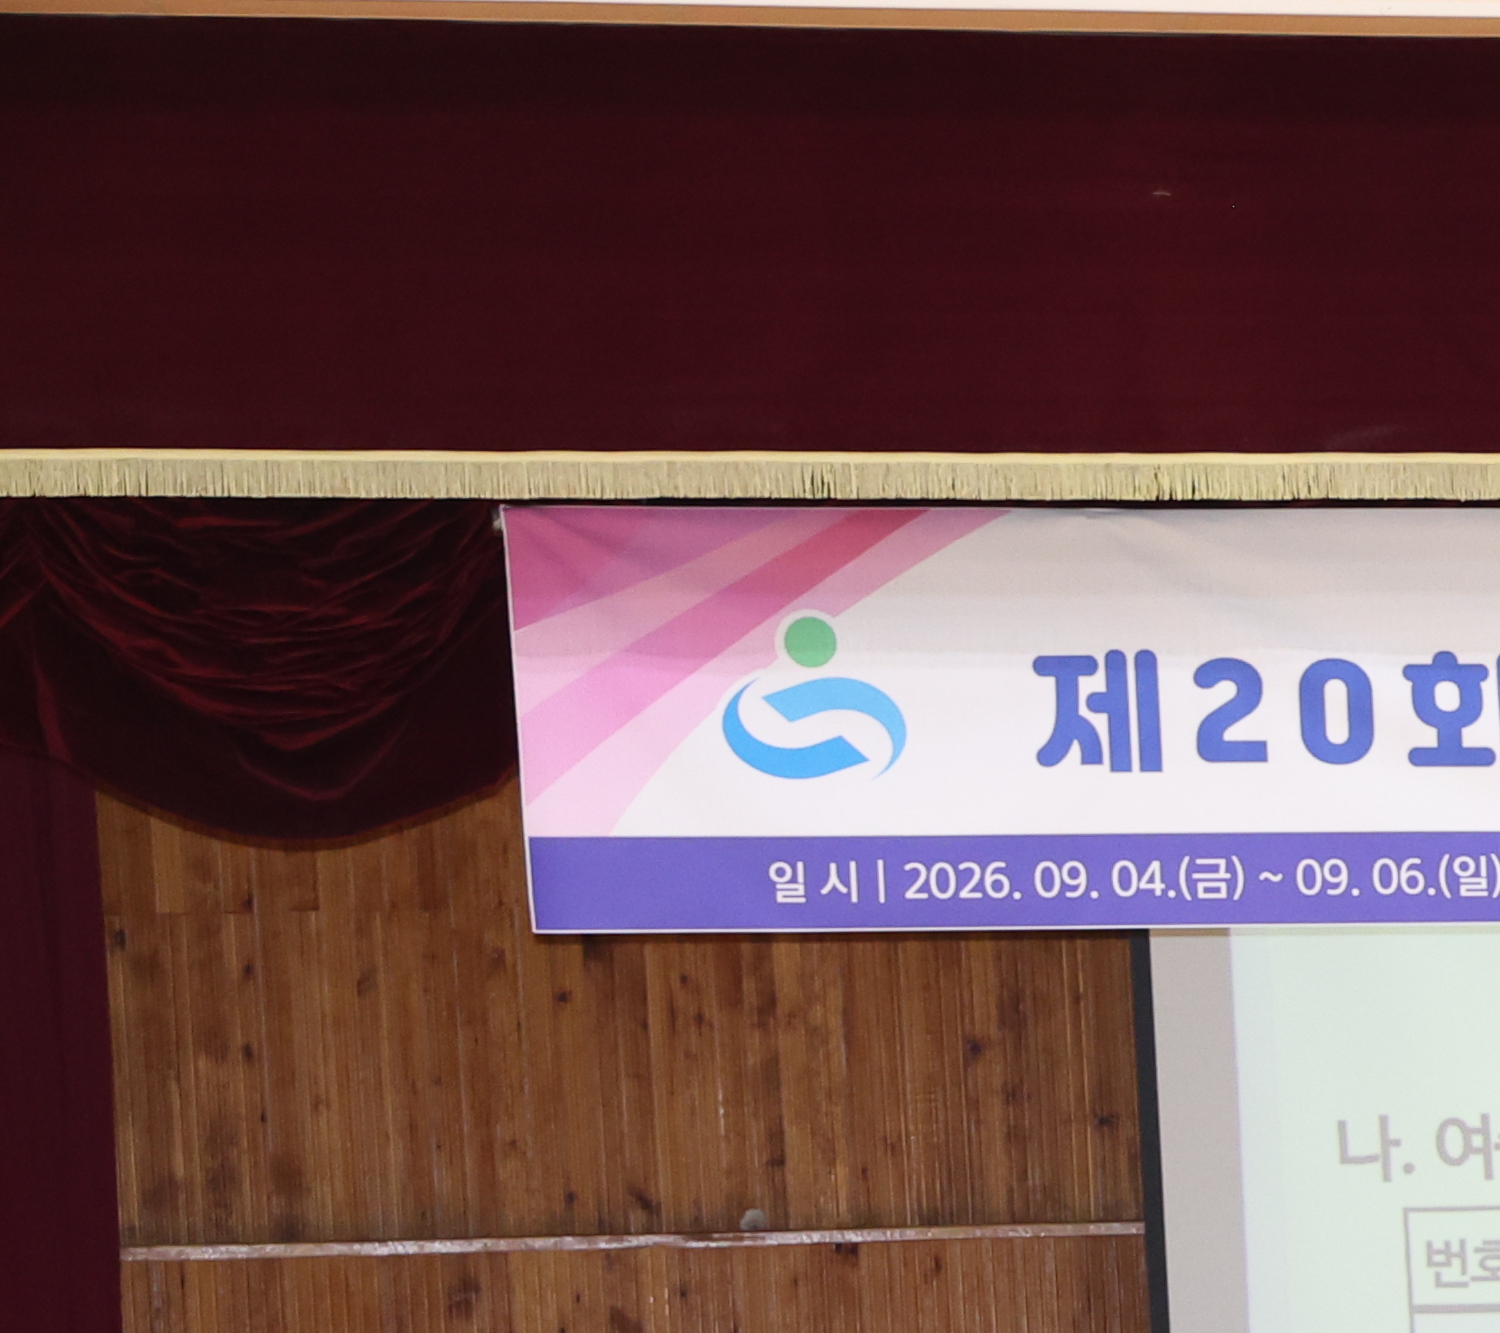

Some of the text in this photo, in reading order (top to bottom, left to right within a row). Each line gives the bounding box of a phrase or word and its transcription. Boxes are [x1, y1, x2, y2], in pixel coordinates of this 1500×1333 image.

[904, 862, 1021, 899] 2026.
[1035, 861, 1099, 898] 09.
[1112, 856, 1244, 900] 04.(금)
[1297, 859, 1359, 896] 09.
[1337, 1114, 1415, 1182] 나.
